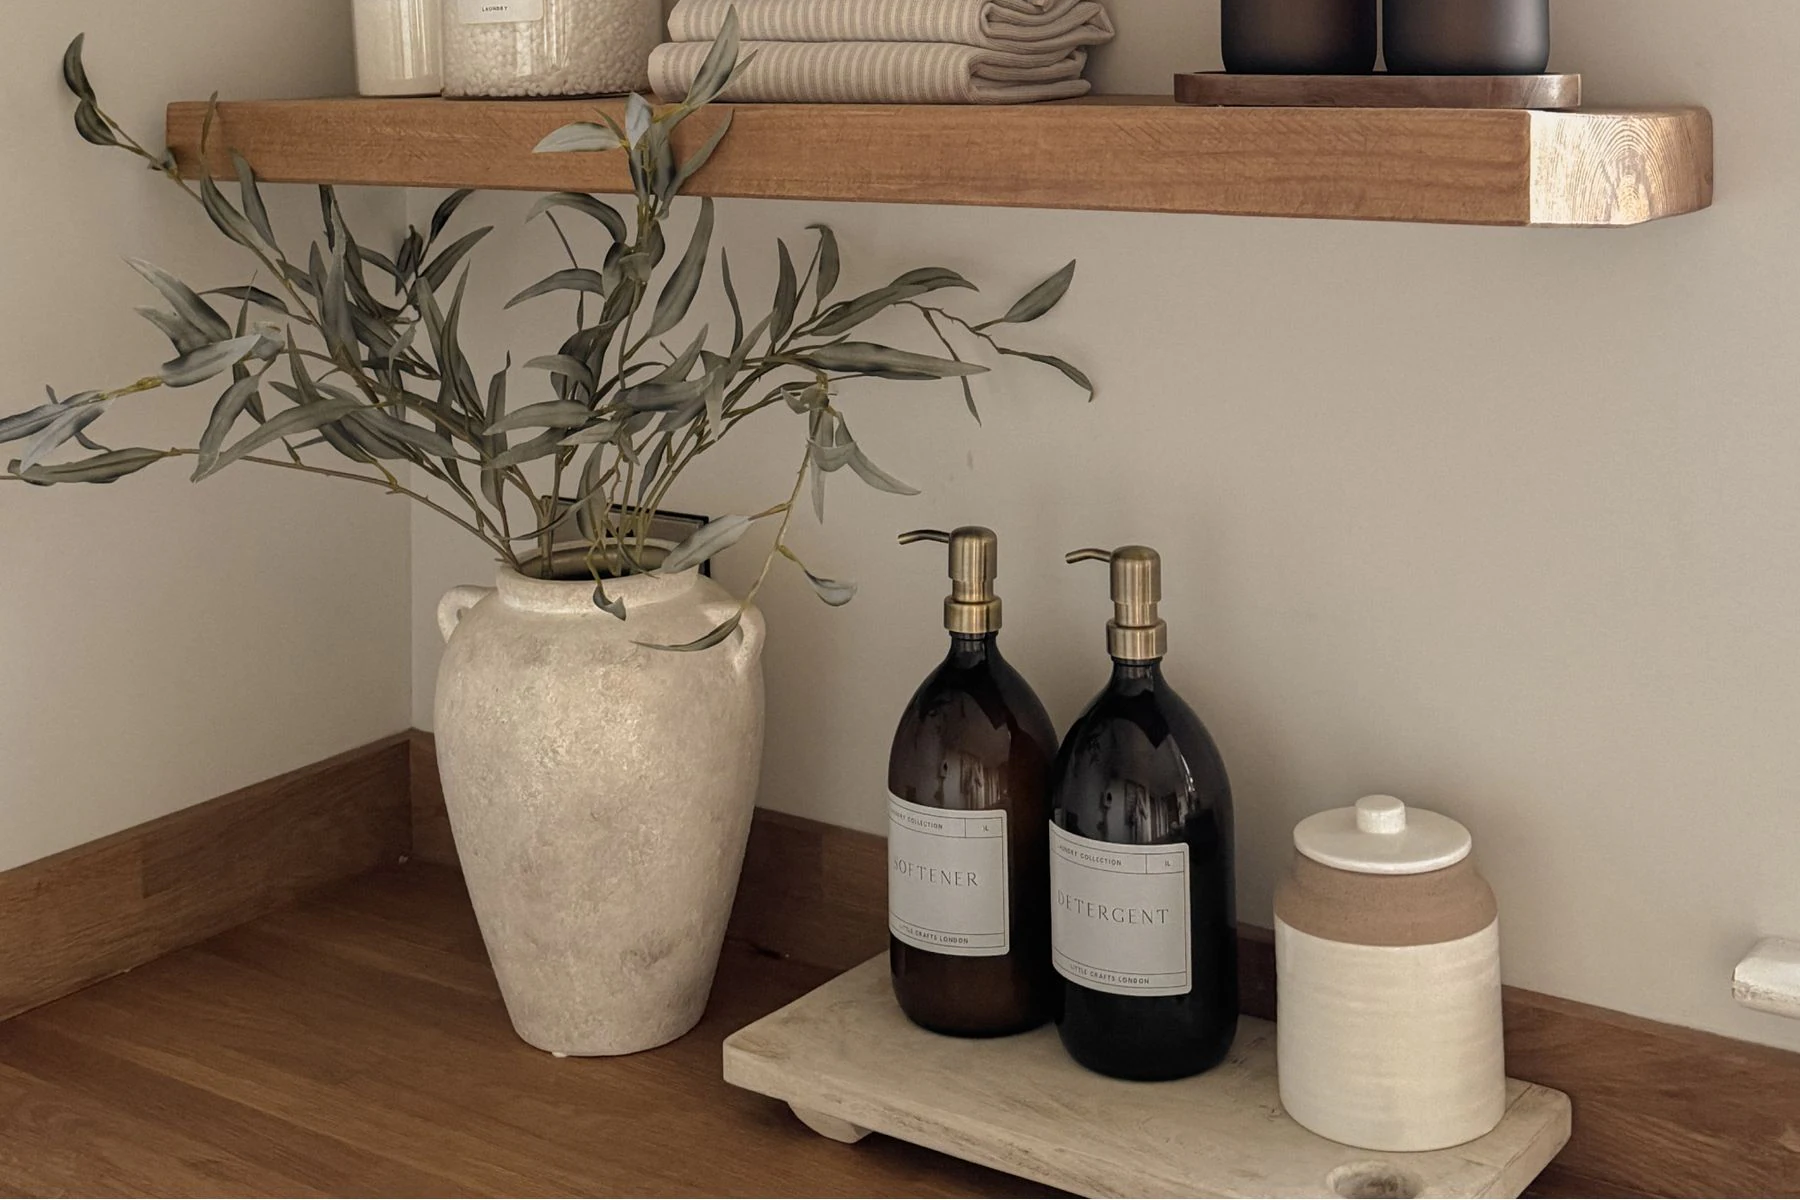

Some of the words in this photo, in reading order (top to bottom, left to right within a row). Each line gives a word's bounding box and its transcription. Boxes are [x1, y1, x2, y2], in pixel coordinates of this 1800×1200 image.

[907, 816, 943, 830] COLLECTION
[1080, 852, 1122, 867] COLLECTION
[893, 857, 979, 888] SOFTENER
[1057, 888, 1170, 926] DETERGENT
[939, 936, 969, 945] LONDON
[1089, 970, 1116, 982] CRAFTS
[1118, 976, 1150, 986] LONDON
